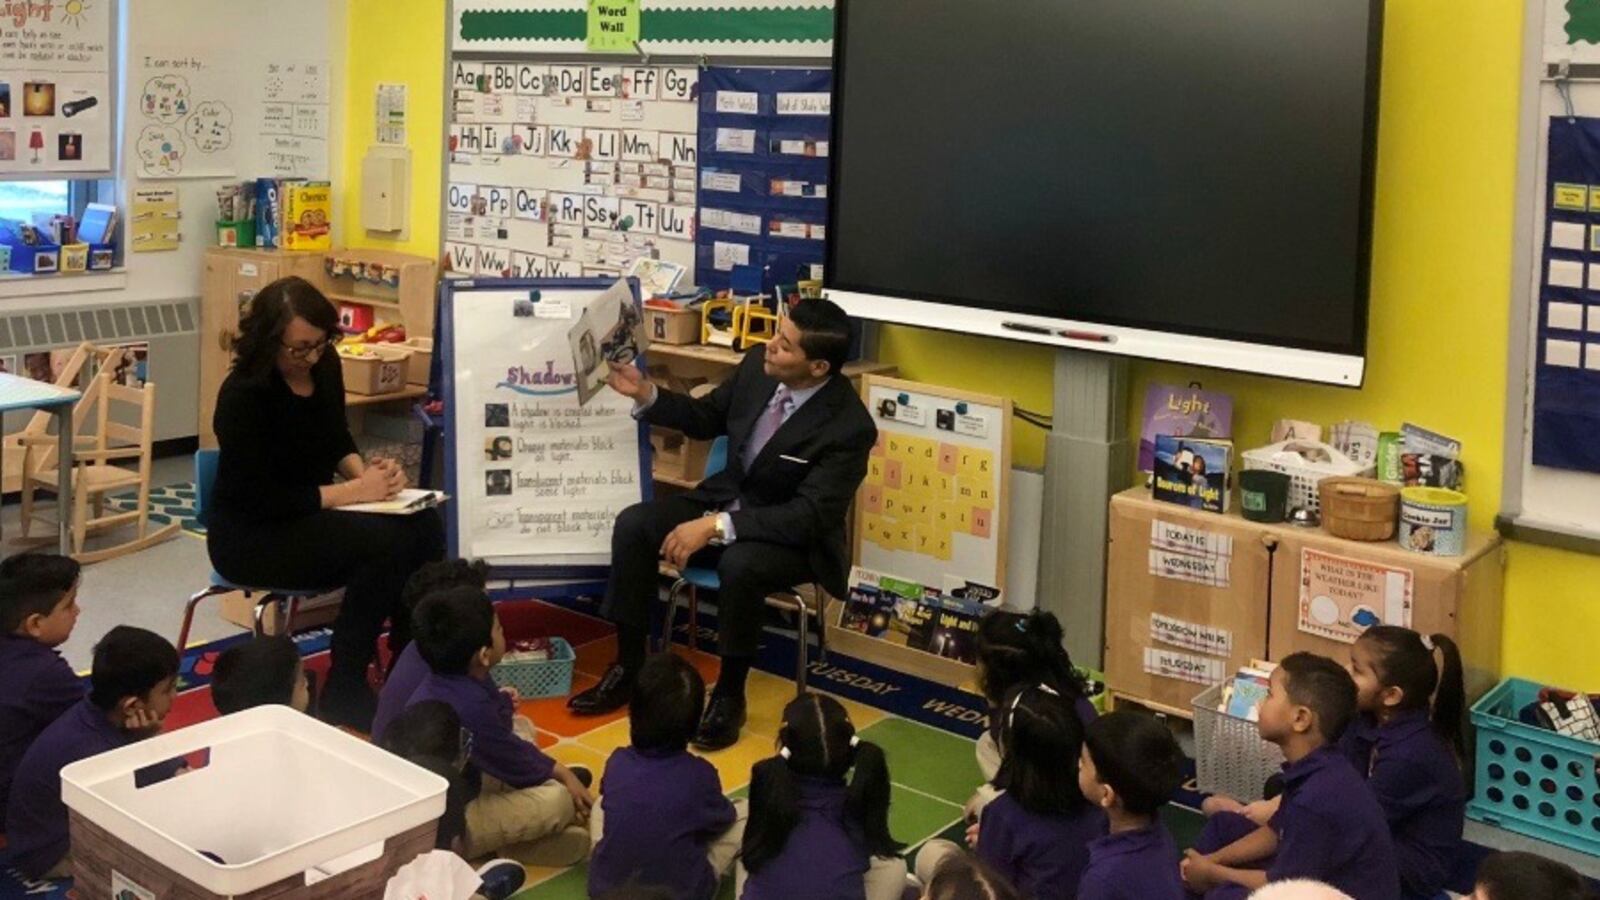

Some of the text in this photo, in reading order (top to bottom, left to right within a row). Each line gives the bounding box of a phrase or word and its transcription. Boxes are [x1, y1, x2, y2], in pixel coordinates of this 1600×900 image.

[598, 6, 627, 17] Word
[600, 22, 625, 32] Wall
[172, 58, 189, 68] sort
[455, 64, 687, 97] Aa Bb Cc Dd Ee Ff Gg
[460, 127, 696, 162] Hh Ii Jj Kk Ll Mm Nn
[449, 186, 468, 208] Oo
[490, 189, 508, 213] Pp
[562, 197, 582, 220] Rr
[586, 197, 607, 222] Ss
[635, 203, 654, 228] Tt
[661, 207, 684, 233] Uu
[455, 246, 472, 268] Vv
[480, 250, 505, 271] Ww
[525, 256, 543, 278] Xx
[512, 402, 615, 418] A shadow is created when
[1168, 393, 1210, 415] Light
[513, 419, 535, 432] light
[539, 420, 547, 429] is
[1284, 426, 1296, 439] A
[550, 437, 590, 451] materials
[591, 436, 614, 451] block
[925, 447, 932, 458] d
[962, 455, 969, 465] f
[980, 459, 988, 471] g
[515, 470, 634, 488] Translucent materials block
[535, 486, 560, 497] some
[981, 489, 988, 499] n
[1187, 483, 1197, 495] of
[1199, 484, 1220, 502] Light
[516, 507, 617, 524] Transparent materials
[886, 499, 893, 508] p
[977, 519, 985, 527] u
[520, 523, 531, 534] do
[536, 523, 551, 533] not
[557, 522, 581, 533] block
[1166, 528, 1206, 546] TODAY IS
[1162, 556, 1217, 574] WEDNESDAY
[1321, 563, 1343, 576] WHAT
[1357, 571, 1374, 581] THE
[1315, 573, 1378, 593] WEATHER LIKE
[806, 660, 902, 696] TUESDAY
